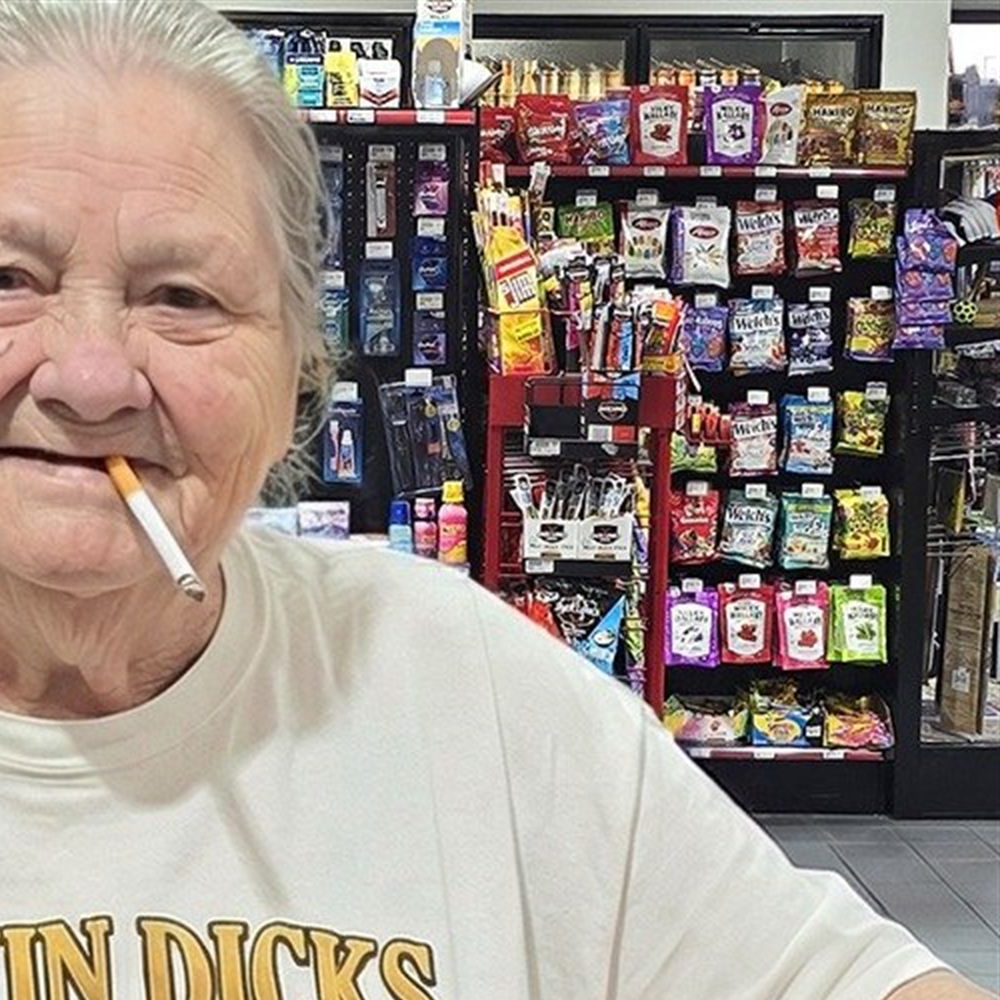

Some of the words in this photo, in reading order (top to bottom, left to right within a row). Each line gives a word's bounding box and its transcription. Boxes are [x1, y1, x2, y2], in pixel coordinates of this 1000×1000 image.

[737, 213, 781, 230] Welch's
[735, 314, 780, 330] Welch's
[727, 504, 771, 522] Welch's
